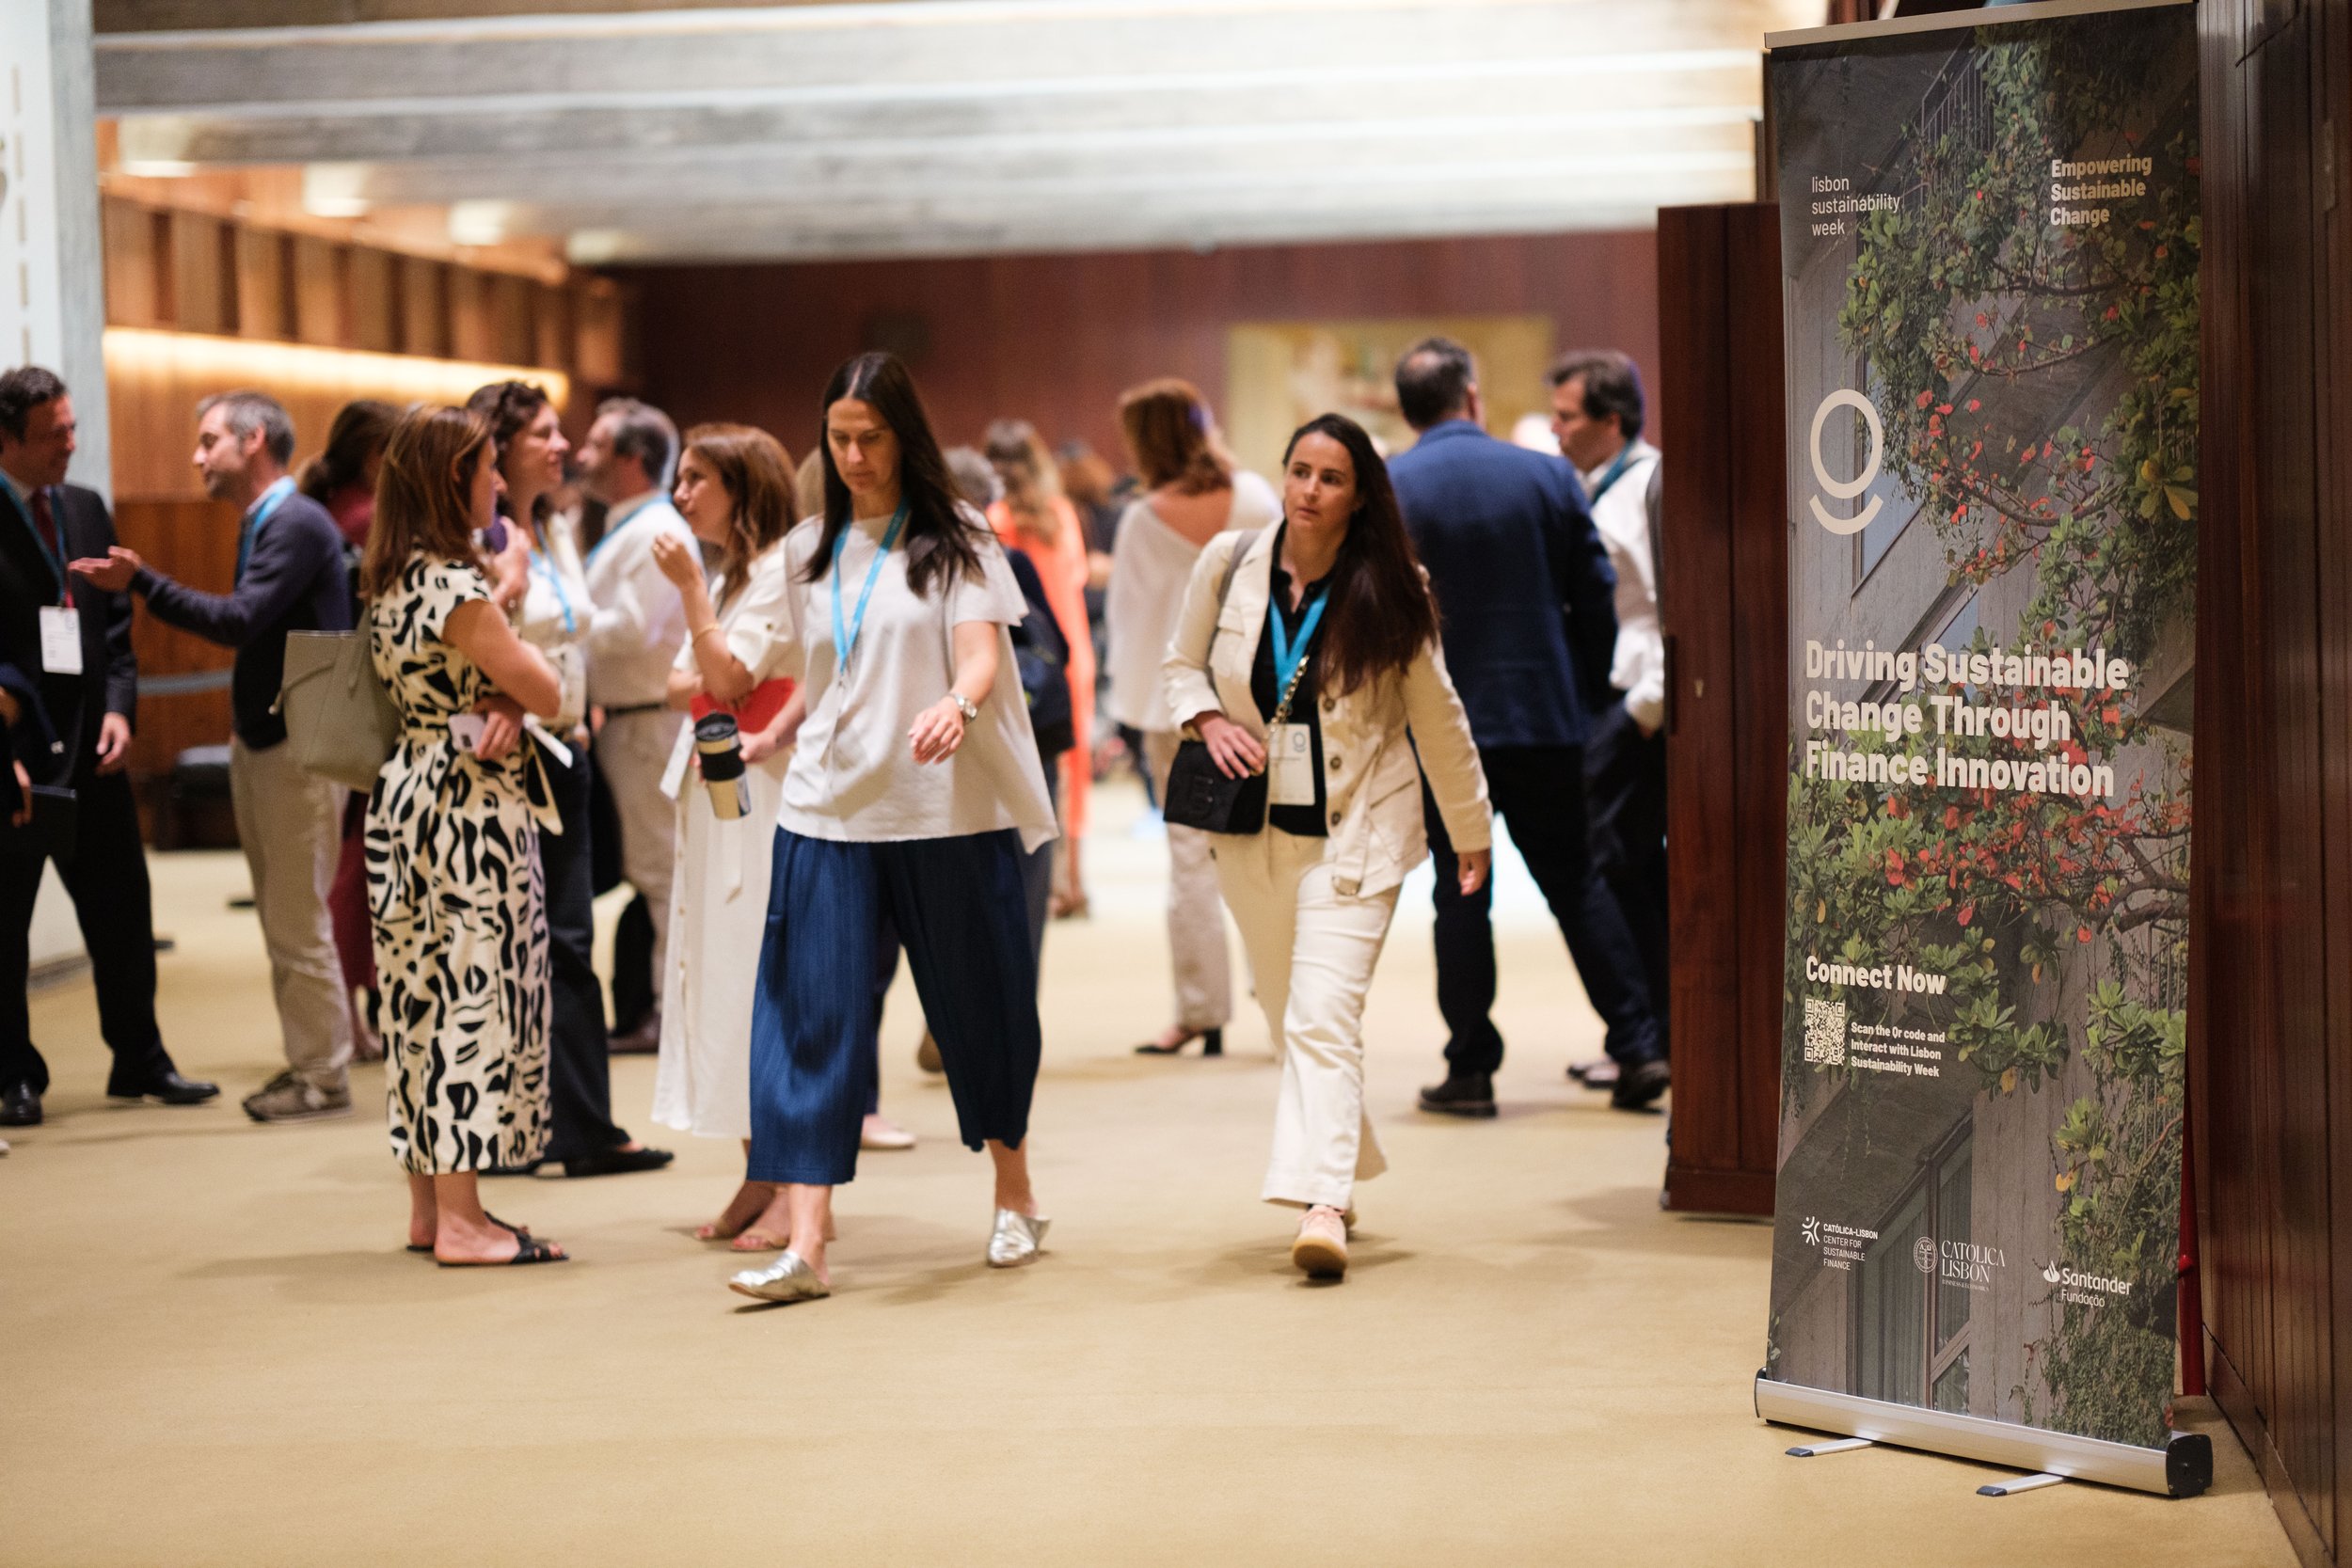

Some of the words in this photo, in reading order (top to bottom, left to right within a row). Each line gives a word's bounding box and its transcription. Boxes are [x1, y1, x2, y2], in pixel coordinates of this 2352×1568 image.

[2051, 152, 2153, 181] Empowering
[1811, 175, 1850, 193] lisbon
[2051, 178, 2146, 201] Sustainable
[1811, 193, 1900, 214] sustainability
[1811, 218, 1845, 236] week
[2051, 207, 2110, 228] Change
[1805, 640, 1917, 691] Driving
[1925, 643, 2129, 689] Sustainable
[1805, 690, 1923, 742] Change
[1931, 695, 2071, 750] Through
[1805, 739, 1929, 785] Finance
[1936, 747, 2115, 797] Innovation
[1805, 955, 1893, 990] Connect
[1897, 964, 1947, 995] Now
[1851, 1022, 1874, 1035] Scan
[1875, 1024, 1890, 1037] the
[1892, 1026, 1902, 1039] Qr
[1903, 1028, 1926, 1040] code
[1927, 1032, 1946, 1043] and
[1851, 1039, 1888, 1053] Interact
[1889, 1043, 1909, 1056] with
[1910, 1047, 1942, 1060] Lisbon
[1851, 1055, 1913, 1076] Sustainability
[1914, 1063, 1940, 1077] Week
[1823, 1223, 1879, 1240] CATÓLICA-LISBON
[1823, 1234, 1849, 1247] CENTER
[1849, 1239, 1862, 1248] FOR
[1823, 1246, 1866, 1261] SUSTAINABLE
[1823, 1258, 1851, 1271] FINANCE
[1942, 1258, 1991, 1283] LISBON
[2062, 1267, 2132, 1295] Santander
[2061, 1289, 2106, 1308] Fundação
